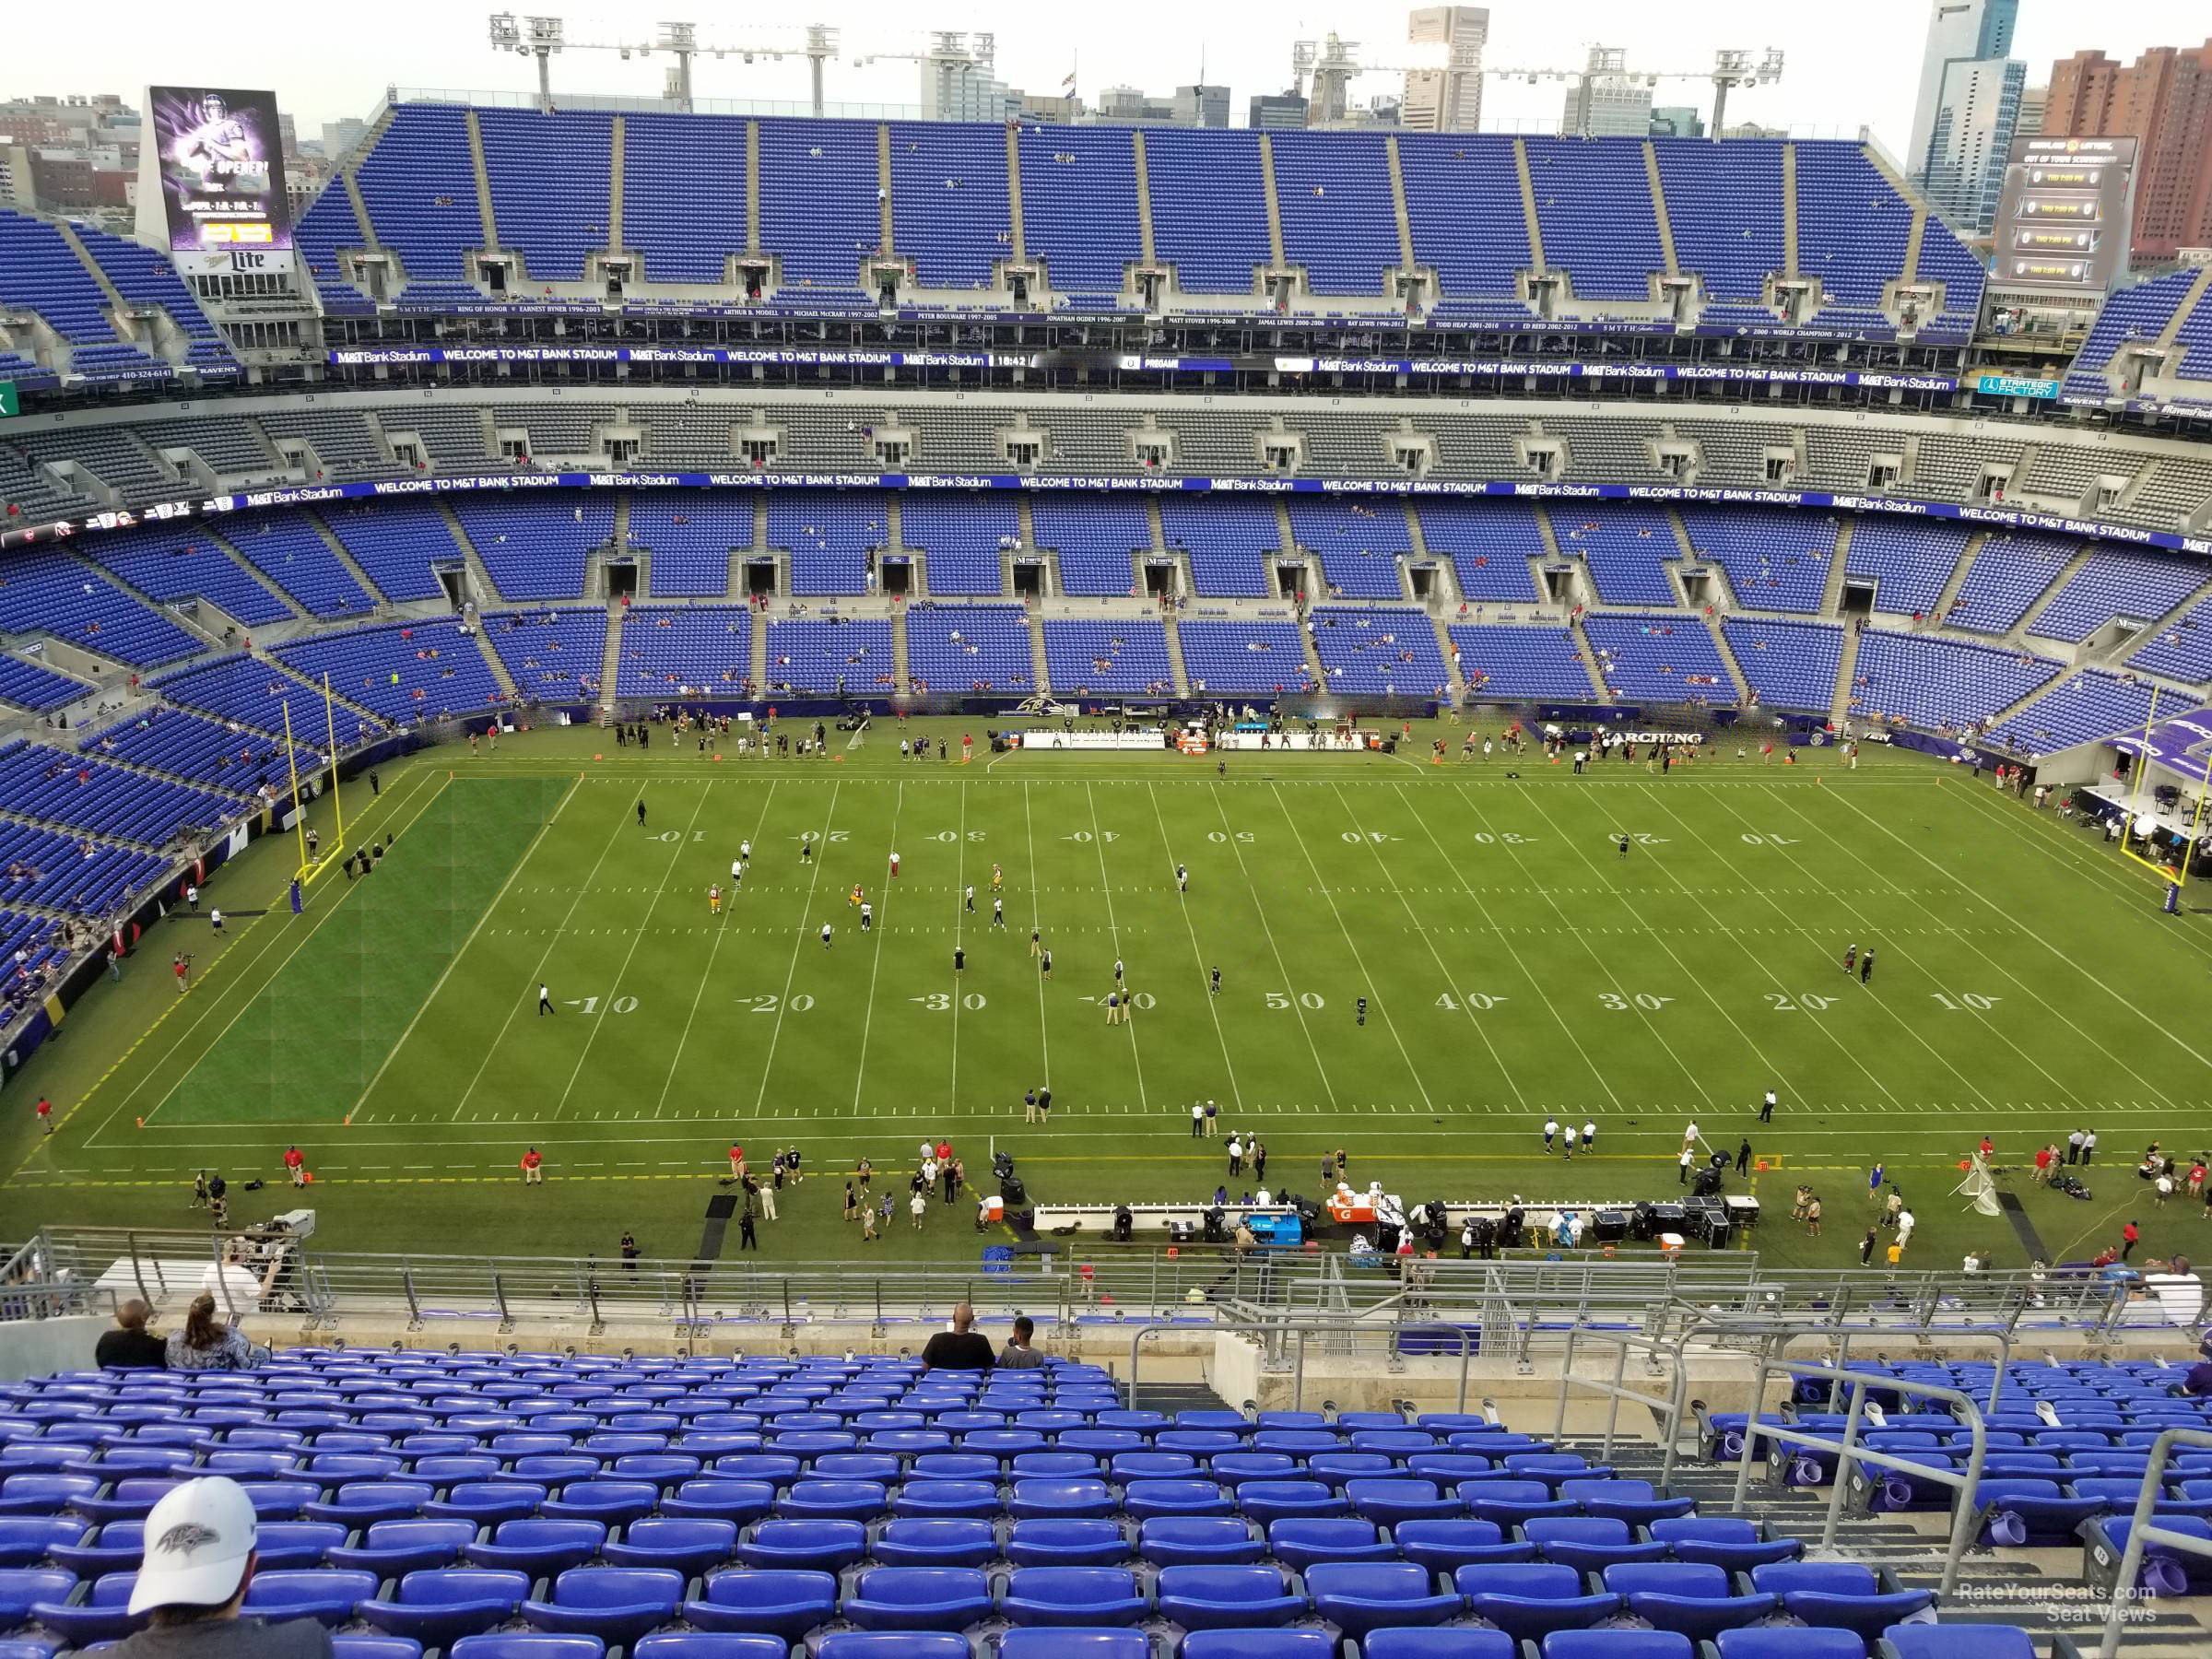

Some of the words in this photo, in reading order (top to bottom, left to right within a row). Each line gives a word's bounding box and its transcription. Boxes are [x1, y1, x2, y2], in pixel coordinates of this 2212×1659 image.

[229, 252, 265, 272] Lite
[337, 352, 363, 363] M&T
[364, 352, 389, 362] Bank
[390, 350, 429, 361] Stadium
[443, 350, 498, 359] WELCOME
[500, 350, 515, 359] TO
[518, 349, 539, 359] M&T
[542, 349, 571, 359] BANK
[573, 350, 618, 359] STADIUM
[630, 350, 653, 359] M&T
[654, 350, 677, 359] Bank
[678, 350, 714, 360] Stadium
[727, 352, 778, 361] WELCOME
[781, 352, 794, 361] TO
[796, 353, 818, 362] M&T
[819, 353, 845, 362] BANK
[848, 353, 890, 363] STADIUM
[903, 354, 925, 364] M&T
[926, 355, 947, 364] Bank
[947, 354, 983, 365] Stadium
[199, 366, 237, 374] RAVENS
[1318, 361, 1341, 371] M&T
[1342, 361, 1363, 371] Bank
[1364, 361, 1398, 371] Stadium
[1412, 362, 1459, 372] WELCOME
[1463, 363, 1476, 372] TO
[1477, 363, 1499, 373] M&T
[1500, 364, 1526, 373] BANK
[1529, 365, 1571, 375] STADIUM
[1582, 365, 1605, 376] M&T
[1606, 366, 1627, 376] Bank
[1628, 366, 1665, 377] Stadium
[1677, 368, 1726, 378] WELCOME
[1729, 369, 1744, 378] TO
[1746, 370, 1768, 380] M&T
[1770, 371, 1797, 381] BANK
[1800, 371, 1846, 382] STADIUM
[1859, 374, 1884, 385] M&T
[1884, 376, 1908, 387] Bank
[1909, 378, 1949, 391] Stadium
[1999, 378, 2053, 387] STRATEGIC
[1998, 386, 2052, 396] FACTORY
[375, 480, 432, 493] WELCOME
[434, 480, 451, 489] TO
[453, 477, 476, 488] M&T
[479, 477, 509, 487] BANK
[512, 476, 559, 486] STADIUM
[590, 475, 616, 485] M&T
[617, 475, 640, 485] Bank
[641, 475, 678, 486] Stadium
[710, 475, 762, 485] WELCOME
[765, 476, 779, 485] TO
[782, 476, 804, 485] M&T
[806, 476, 834, 485] BANK
[836, 476, 879, 485] STADIUM
[909, 477, 932, 487] M&T
[933, 477, 954, 487] Bank
[955, 477, 992, 487] Stadium
[1020, 477, 1069, 488] WELCOME
[1072, 478, 1086, 488] TO
[1088, 478, 1109, 488] M&T
[1112, 478, 1137, 488] BANK
[1140, 478, 1182, 488] STADIUM
[1211, 479, 1234, 489] M&T
[1235, 479, 1256, 489] Bank
[1257, 479, 1293, 490] Stadium
[1323, 480, 1372, 490] WELCOME
[1374, 481, 1388, 491] TO
[1391, 481, 1412, 491] M&T
[1414, 482, 1441, 491] BANK
[1443, 483, 1487, 493] STADIUM
[1514, 484, 1539, 494] M&T
[1539, 485, 1561, 495] Bank
[1562, 485, 1599, 496] Stadium
[247, 494, 273, 506] M&T
[274, 491, 300, 503] Bank
[300, 488, 342, 500] Stadium
[1630, 487, 1680, 498] WELCOME
[1683, 488, 1698, 498] TO
[1700, 489, 1722, 500] M&T
[1724, 490, 1752, 500] BANK
[1755, 491, 1802, 502] STADIUM
[1832, 495, 1859, 507] M&T
[1860, 498, 1884, 510] Bank
[1885, 500, 1925, 513] Stadium
[1959, 507, 2018, 524] WELCOME
[2020, 513, 2037, 525] TO
[2039, 516, 2065, 530] M&T
[2065, 520, 2098, 534] BANK
[2099, 524, 2151, 542] STADIUM
[2183, 536, 2212, 553] M&T
[1604, 732, 1704, 745] ARCHING
[661, 830, 707, 842] 10
[798, 830, 852, 842] 20
[937, 830, 986, 842] 30
[1074, 830, 1120, 842] 40
[1207, 831, 1255, 843] 50
[1342, 831, 1392, 843] 40
[1476, 831, 1524, 844] 30
[1608, 832, 1659, 845] 20
[1741, 833, 1792, 845] 10
[581, 995, 640, 1014] 10
[752, 994, 816, 1012] 20
[925, 994, 986, 1011] 30
[1265, 993, 1325, 1010] 50
[1435, 993, 1493, 1010] 40
[1599, 994, 1661, 1011] 30
[1764, 994, 1830, 1011] 20
[1932, 994, 1993, 1011] 10
[1341, 1210, 1351, 1218] G
